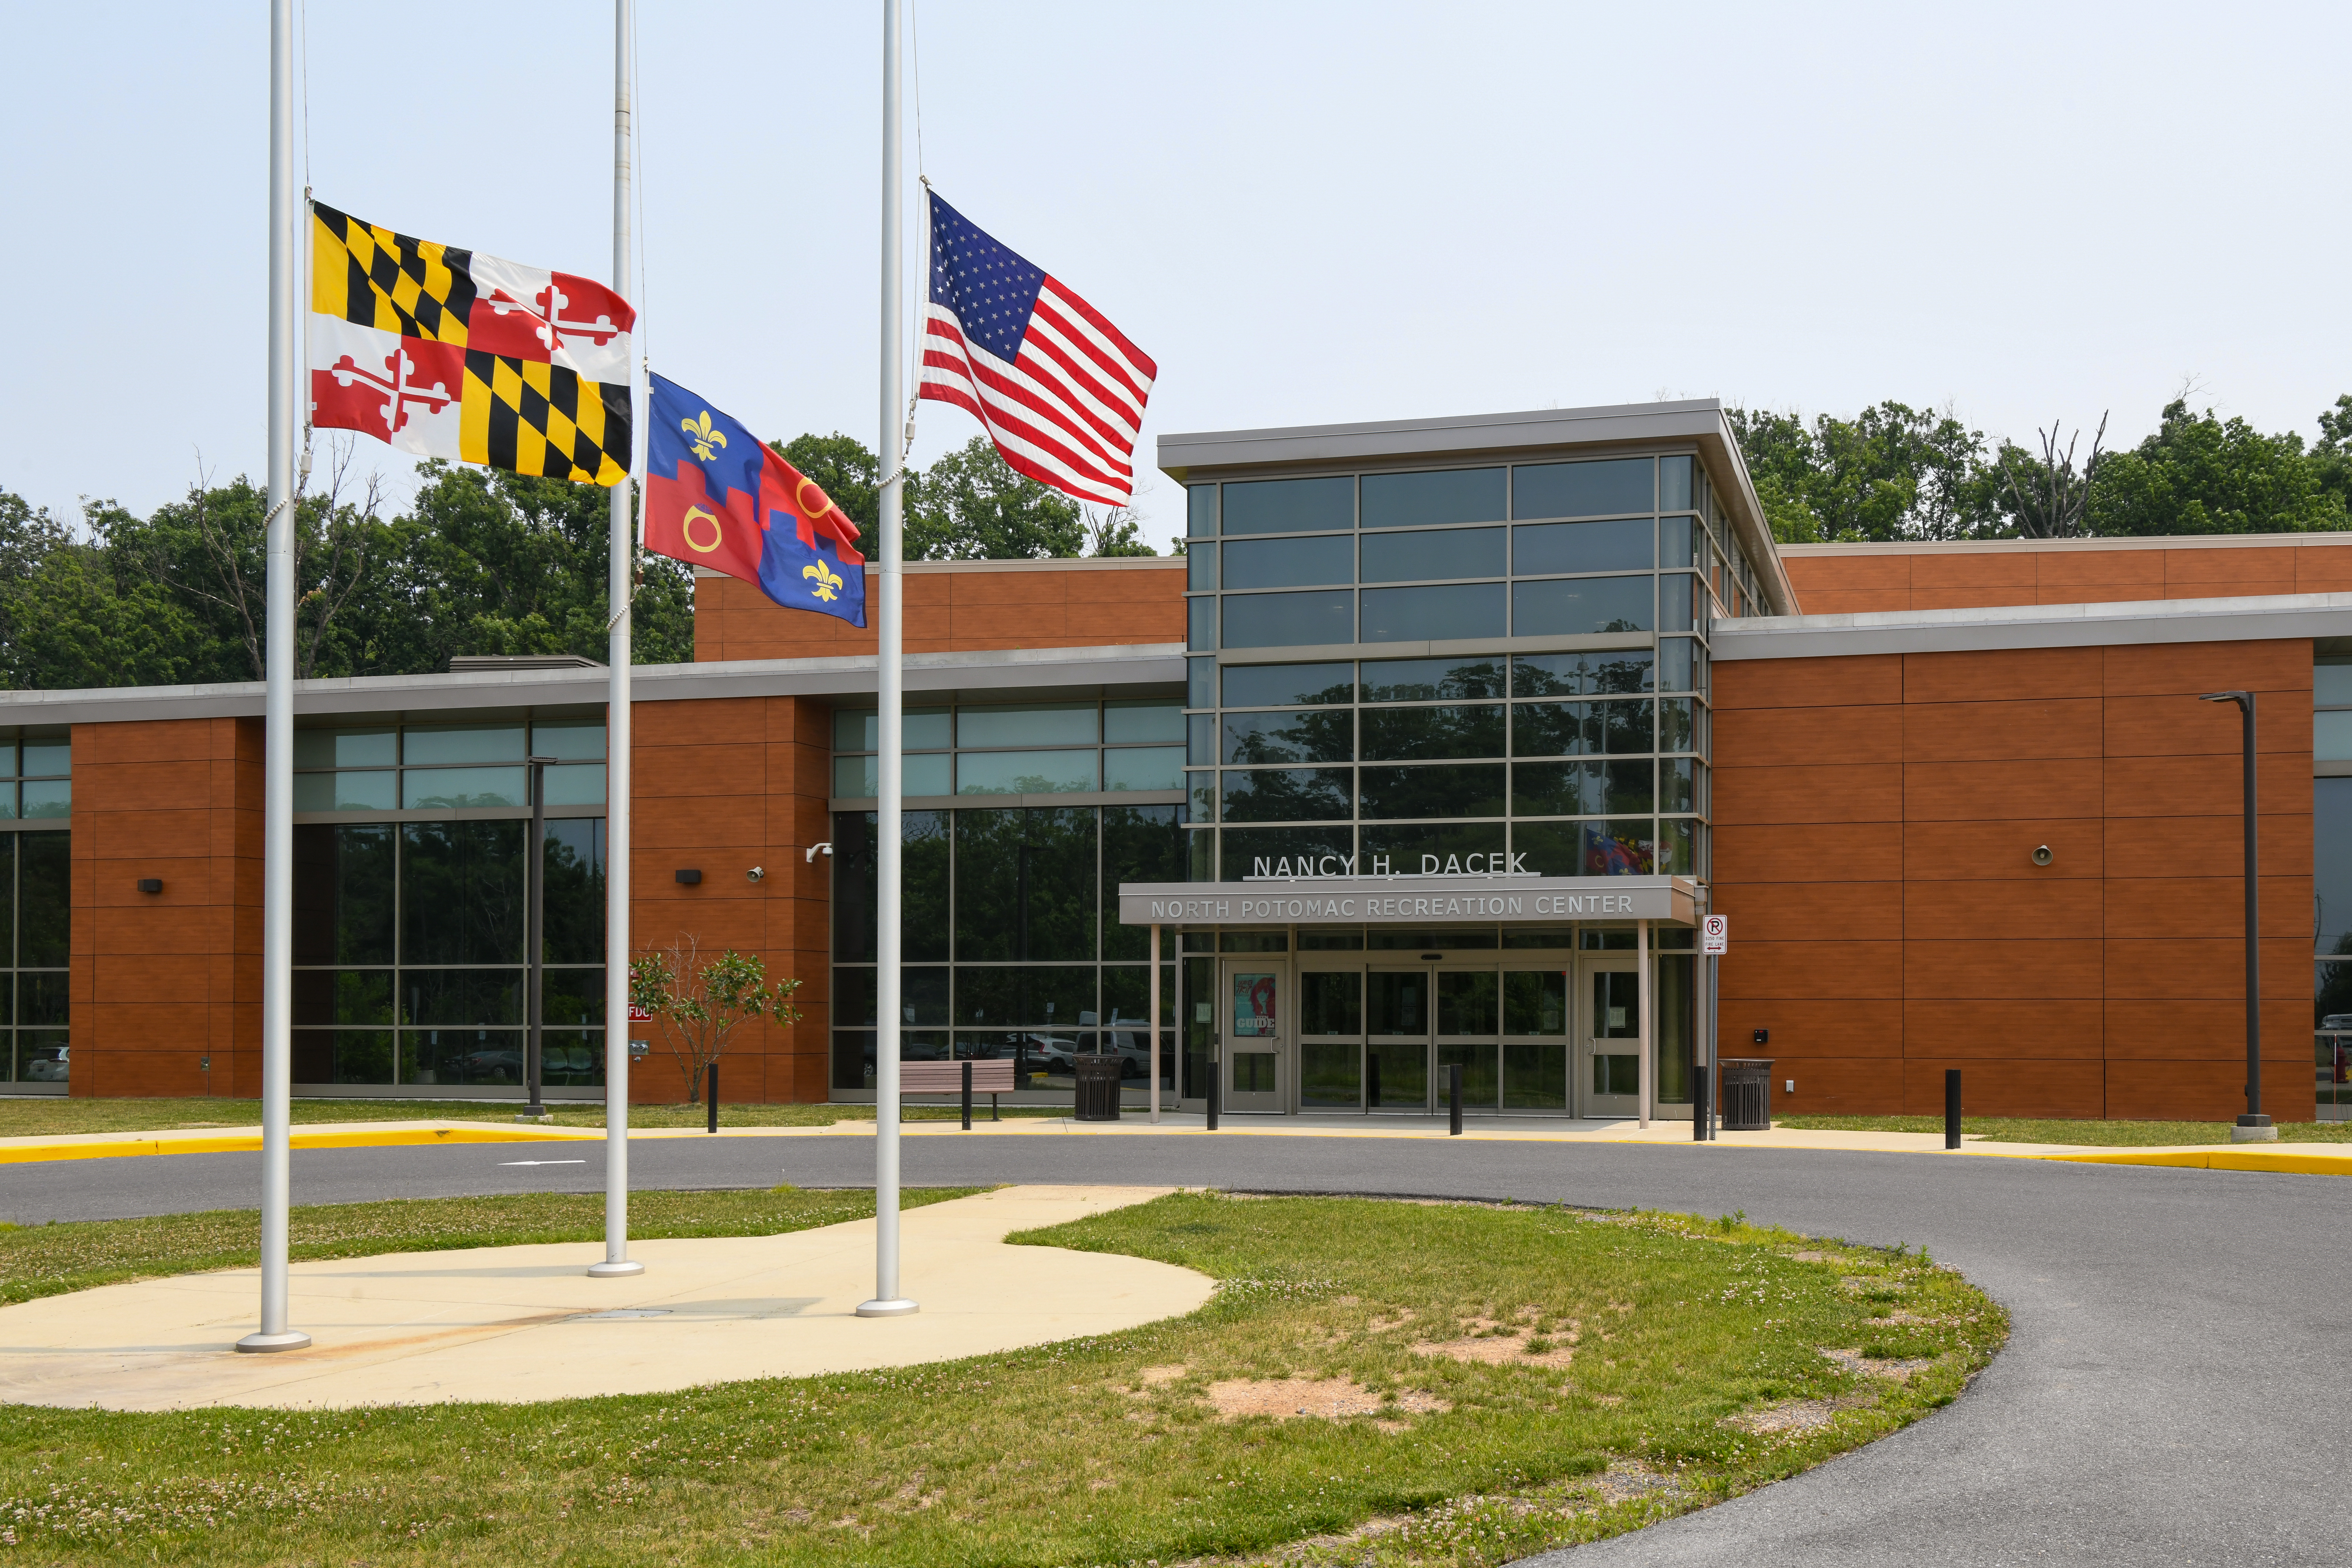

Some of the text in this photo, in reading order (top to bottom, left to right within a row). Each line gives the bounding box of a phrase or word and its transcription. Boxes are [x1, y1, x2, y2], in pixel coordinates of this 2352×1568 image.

[1254, 852, 1528, 877] NANCY H. DACEK
[1152, 895, 1633, 918] NORTH POTOMAC RECREATION CENTER
[1236, 1018, 1275, 1028] GUIDE
